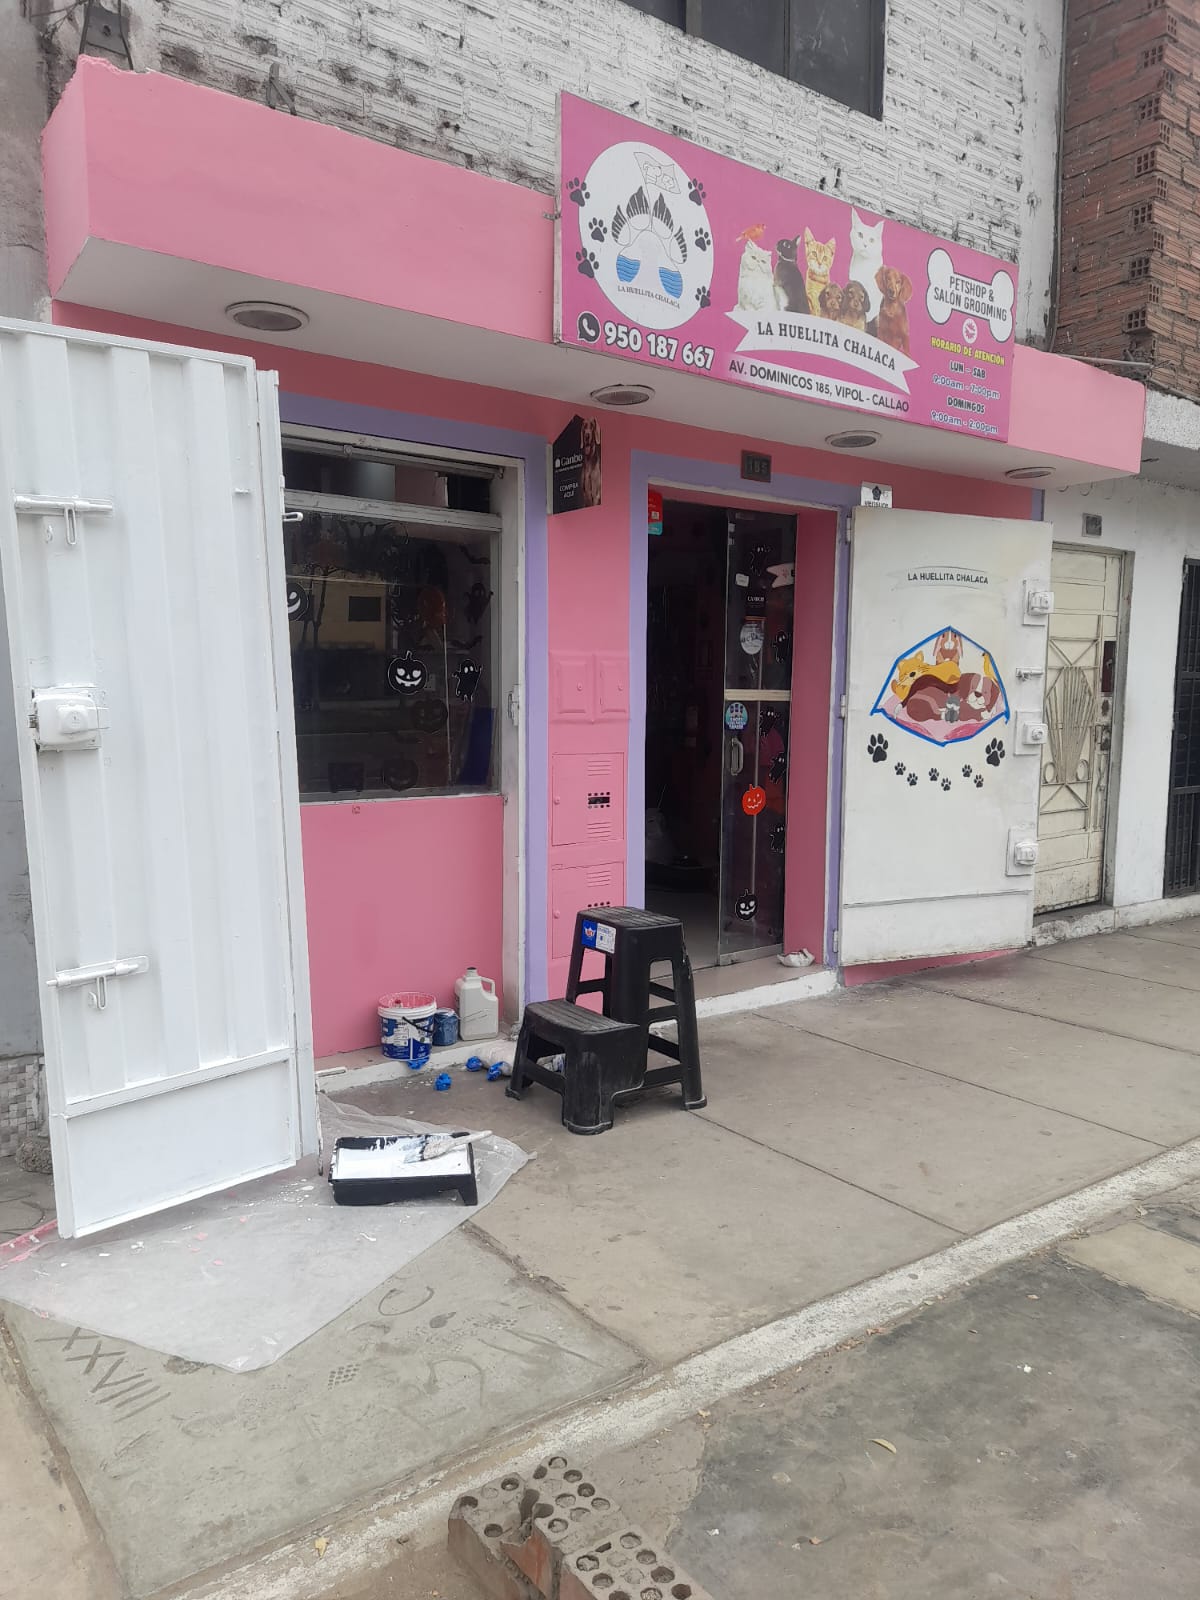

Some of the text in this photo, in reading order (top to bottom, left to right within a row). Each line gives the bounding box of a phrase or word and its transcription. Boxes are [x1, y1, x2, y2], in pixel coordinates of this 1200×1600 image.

[617, 285, 626, 293] LA
[949, 276, 995, 302] PETSHOP &
[934, 286, 1007, 321] SALÓN GROOMING
[603, 320, 715, 371] 950 187 667
[757, 321, 895, 371] LA HUELLITA CHALACA
[931, 336, 961, 353] HORARIO
[963, 346, 972, 357] DE
[950, 360, 964, 373] LUN
[972, 367, 986, 379] SAB
[729, 359, 747, 375] AV.
[750, 364, 813, 390] DOMINICOS
[815, 381, 833, 397] 185,
[835, 384, 864, 403] VIPOL
[872, 393, 909, 412] CALLAO
[933, 374, 963, 390] 9:00am
[947, 396, 985, 414] DOMINGOS
[931, 410, 962, 426] 9:00am
[969, 419, 998, 435] 2:00pm
[907, 572, 989, 584] LA HUELLITA CHALACA
